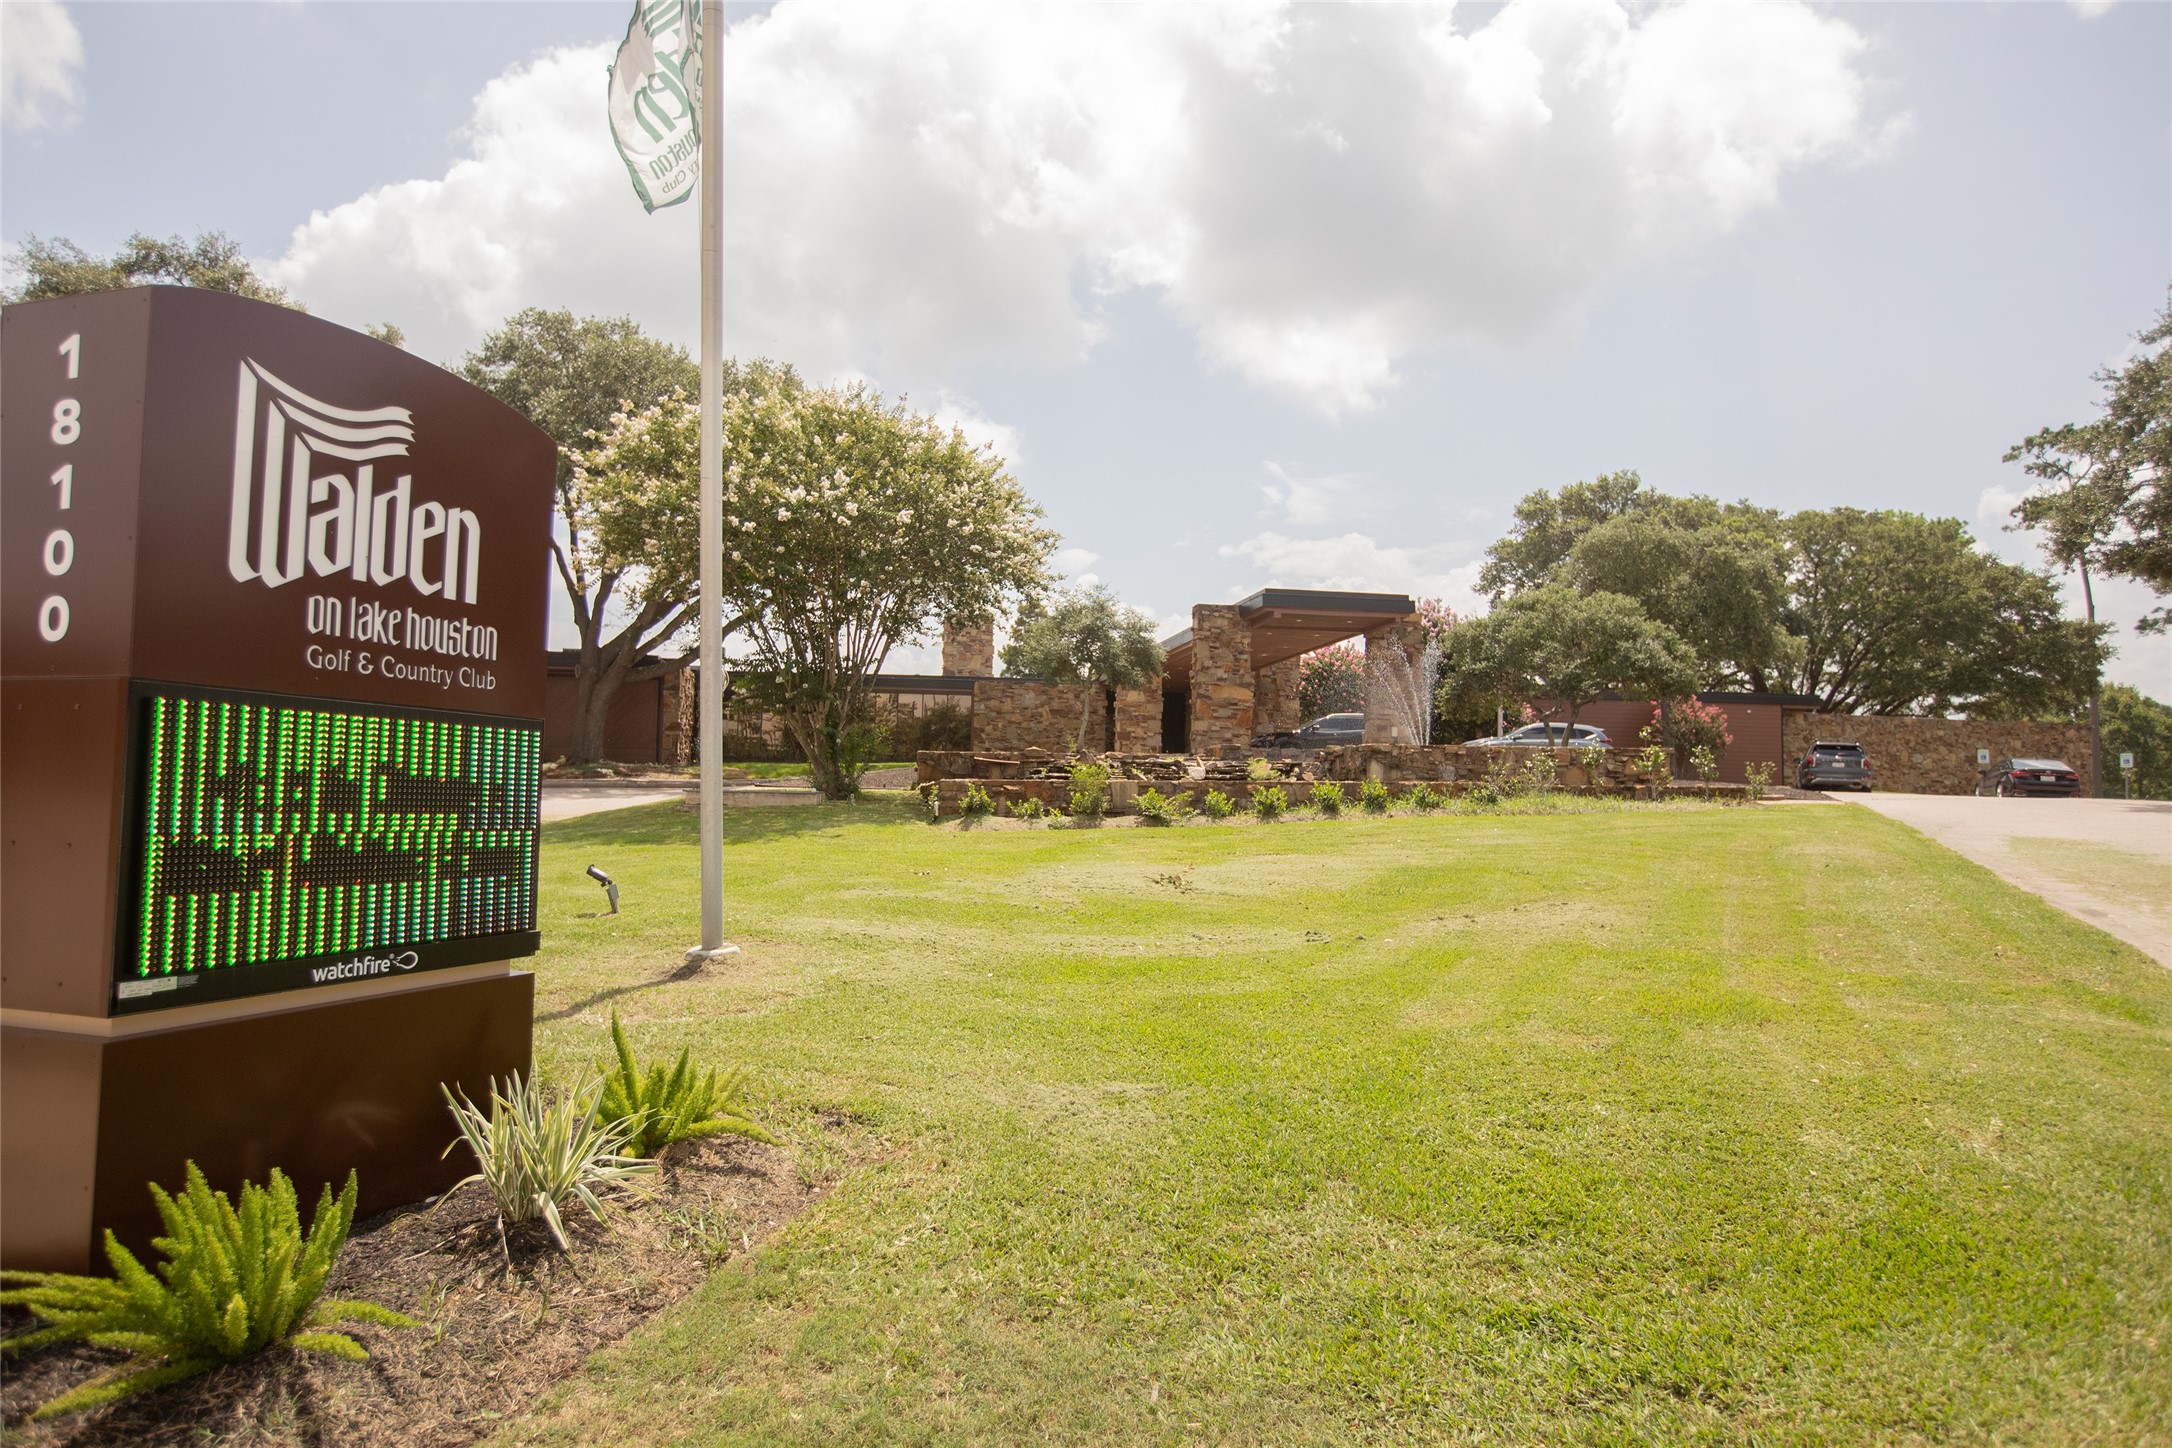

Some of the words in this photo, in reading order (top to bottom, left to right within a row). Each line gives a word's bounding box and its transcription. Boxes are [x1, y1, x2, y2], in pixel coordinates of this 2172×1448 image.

[228, 356, 481, 605] Walden
[307, 594, 343, 637] on
[349, 596, 403, 646] lake
[406, 606, 498, 661] houston
[306, 645, 352, 672] Golf
[358, 652, 374, 675] &
[381, 655, 453, 690] Country
[459, 666, 497, 690] Club
[312, 956, 391, 983] watchfire
